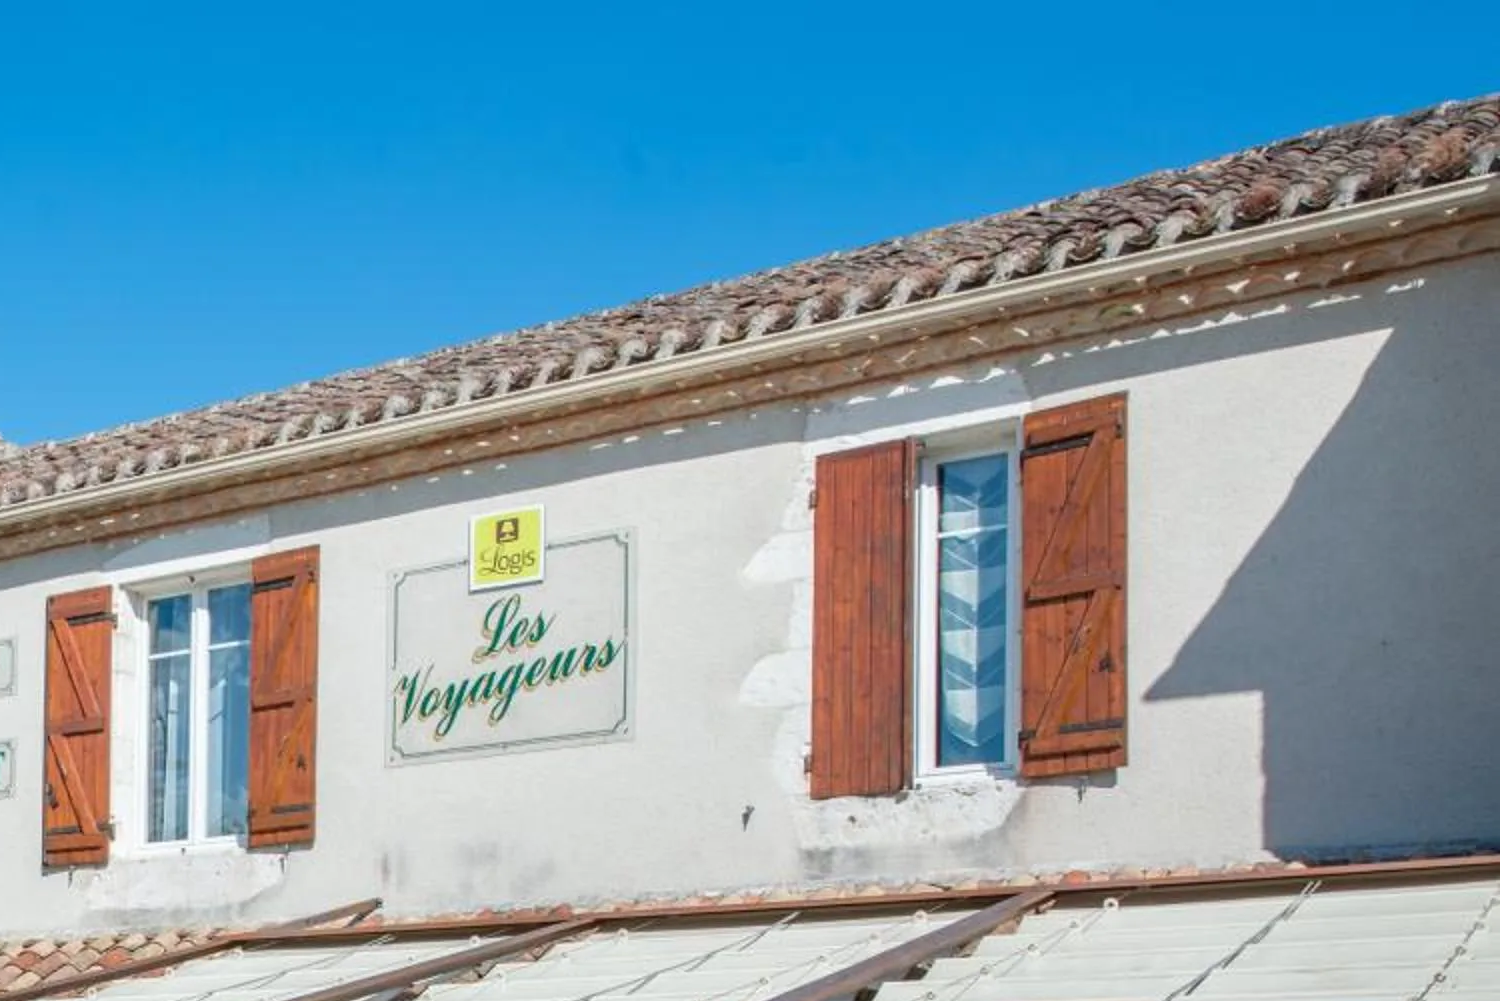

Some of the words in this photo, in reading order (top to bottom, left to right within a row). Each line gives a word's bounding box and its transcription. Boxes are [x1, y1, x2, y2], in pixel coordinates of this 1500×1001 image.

[479, 546, 536, 576] Logis
[472, 593, 556, 663] Les
[394, 635, 627, 740] Voyageurs
